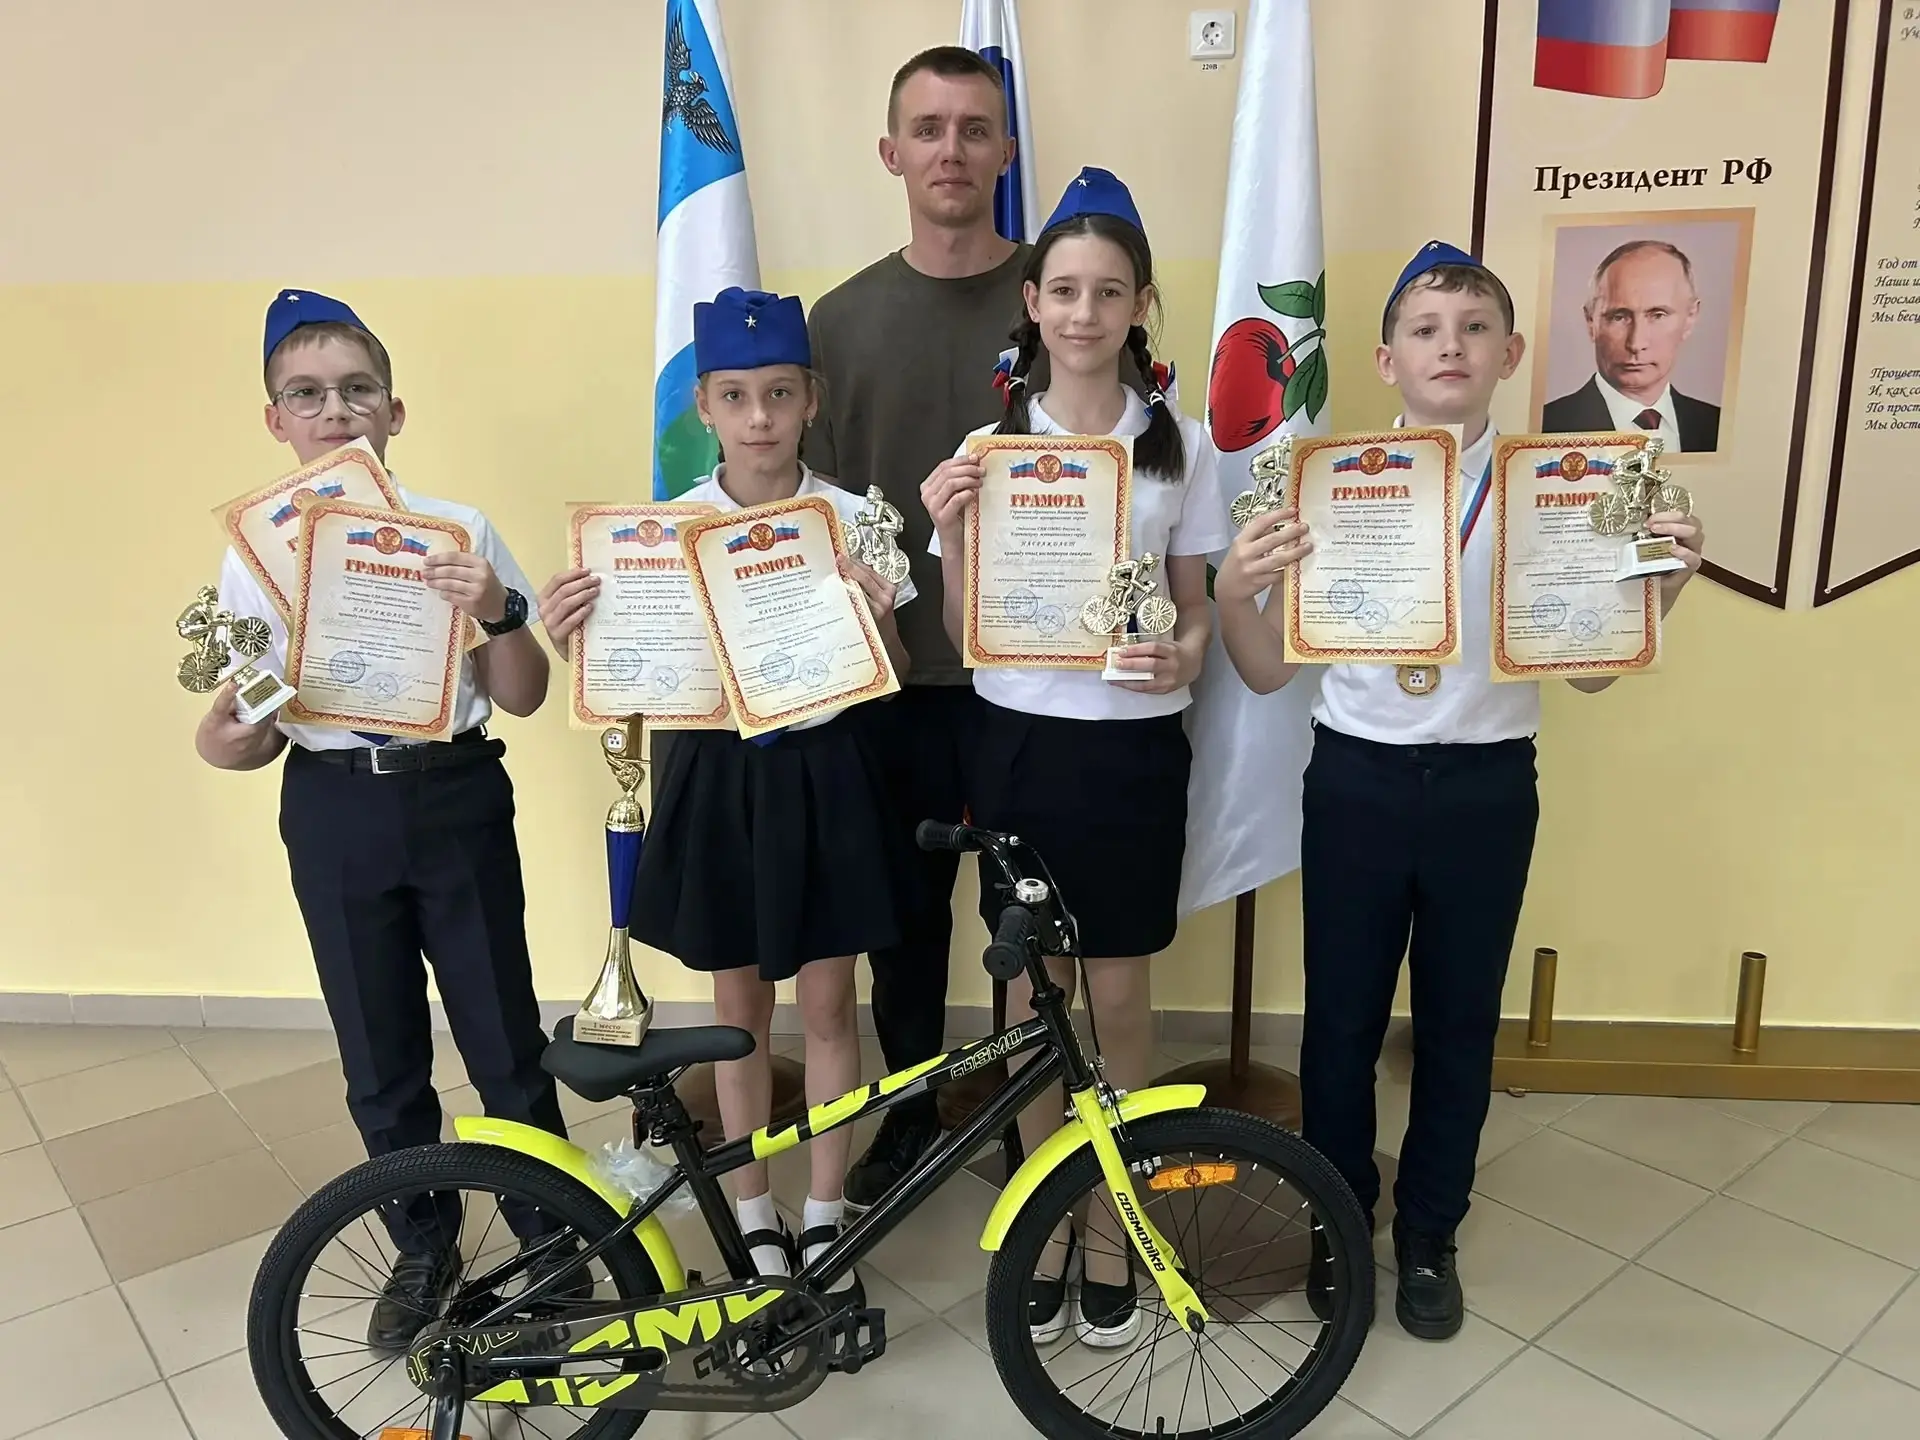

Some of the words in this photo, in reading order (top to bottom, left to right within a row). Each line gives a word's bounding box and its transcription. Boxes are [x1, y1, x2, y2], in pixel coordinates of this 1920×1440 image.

[1533, 165, 1708, 200] Президент
[1721, 157, 1773, 185] РФ
[1877, 257, 1899, 269] Год
[1901, 260, 1917, 269] от
[1874, 276, 1910, 287] Наши
[1871, 312, 1894, 323] Мы
[1886, 386, 1909, 398] как
[1865, 401, 1884, 413] По
[1864, 420, 1888, 431] Мы
[1331, 485, 1411, 501] ГРАМОТА
[1009, 494, 1086, 508] ГРАМОТА
[344, 558, 424, 582] ГРАМОТА
[613, 557, 687, 571] ГРАМОТА
[733, 553, 807, 580] ГРАМОТА
